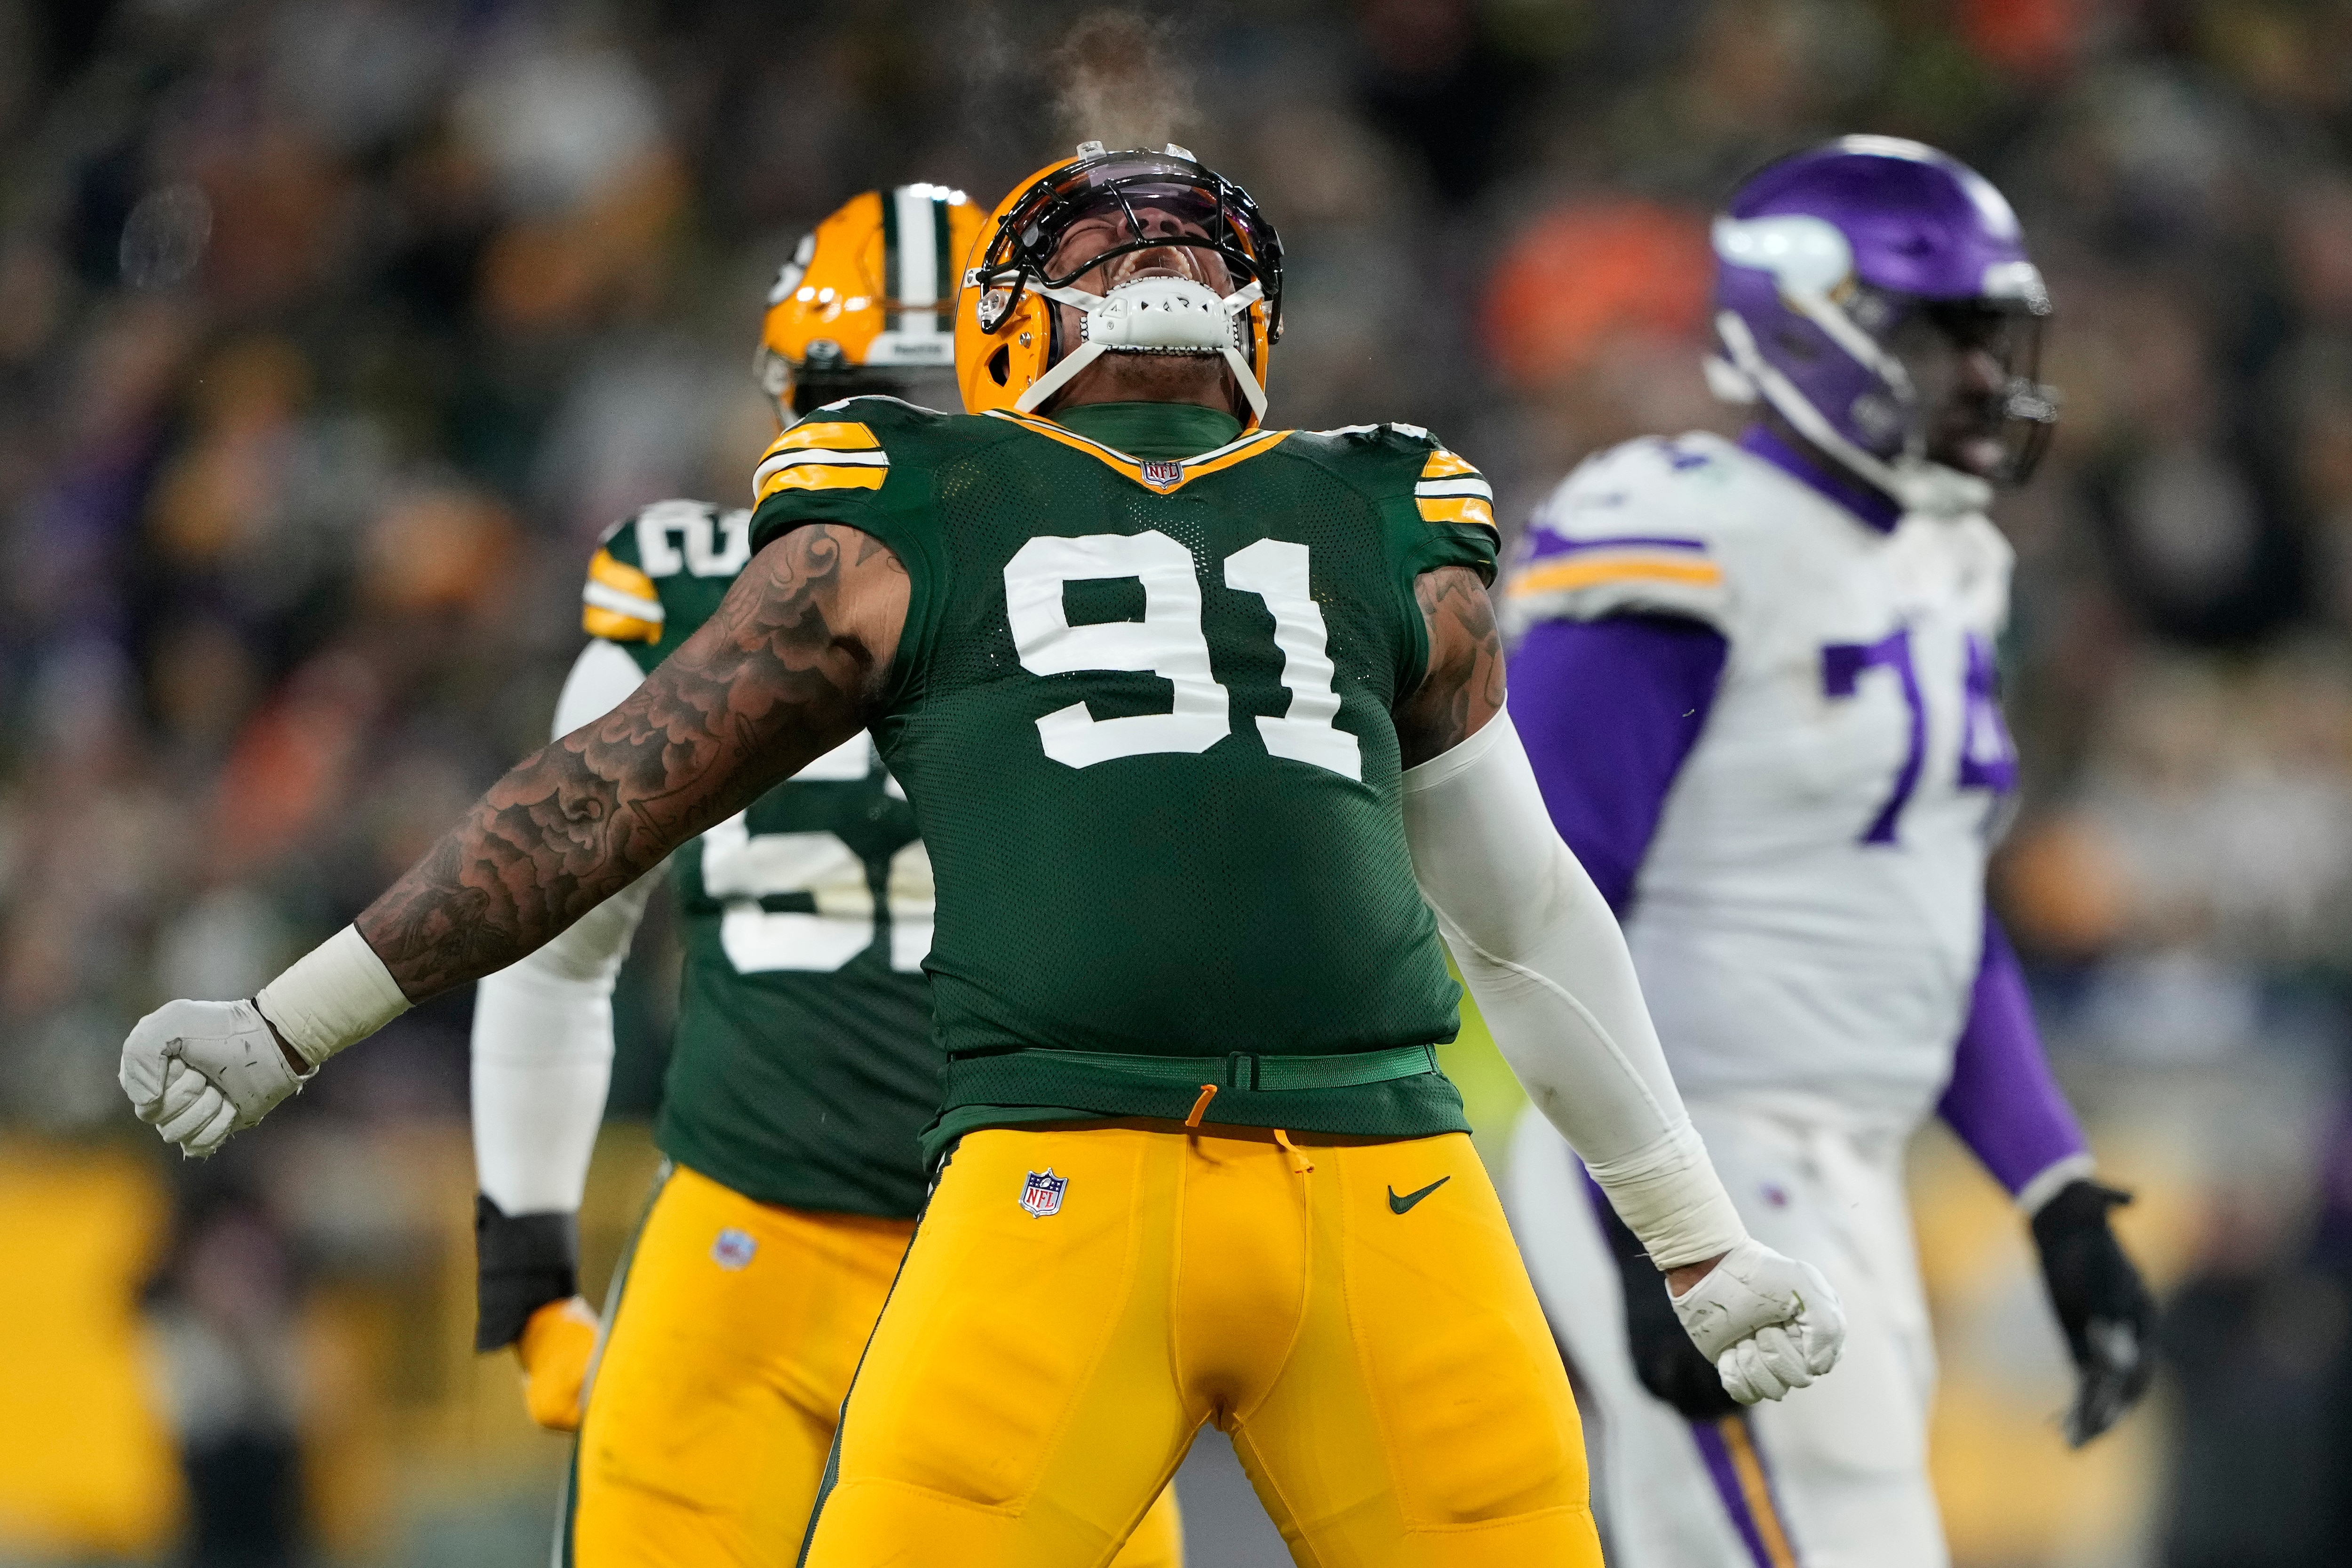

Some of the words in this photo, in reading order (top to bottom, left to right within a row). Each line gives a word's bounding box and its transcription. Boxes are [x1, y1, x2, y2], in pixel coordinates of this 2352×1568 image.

[1149, 466, 1177, 479] NFL
[1003, 529, 1362, 781] 91
[1820, 628, 2018, 844] 74
[1026, 1188, 1054, 1209] NFL
